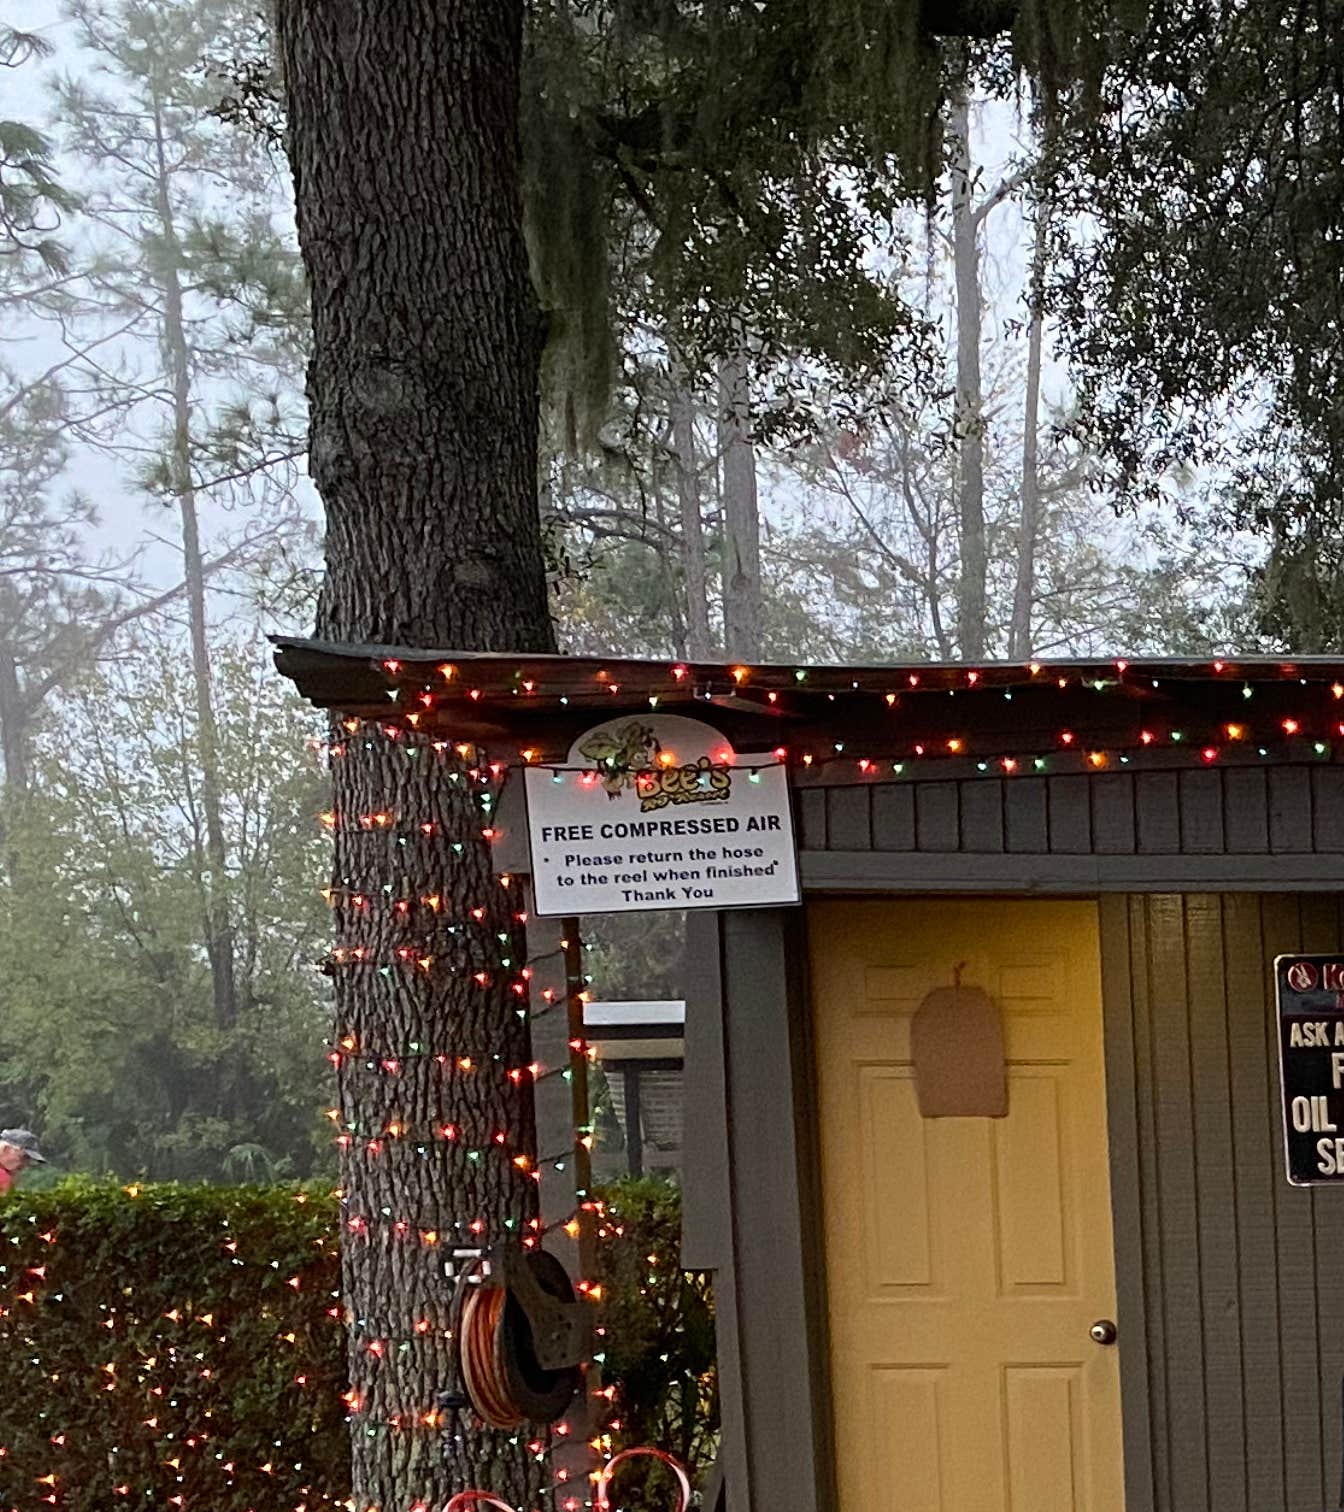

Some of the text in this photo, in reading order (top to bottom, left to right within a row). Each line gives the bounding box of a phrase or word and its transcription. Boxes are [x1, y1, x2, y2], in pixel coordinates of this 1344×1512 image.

[541, 815, 781, 843] FREE COMPRESSED AIR
[564, 846, 764, 868] Please return the hose
[557, 874, 574, 887] to
[580, 871, 608, 886] the
[613, 869, 647, 884] reel
[653, 867, 700, 882] when
[621, 886, 714, 903] Thank You
[1290, 1021, 1330, 1048] ASK
[1291, 1095, 1337, 1133] OIL
